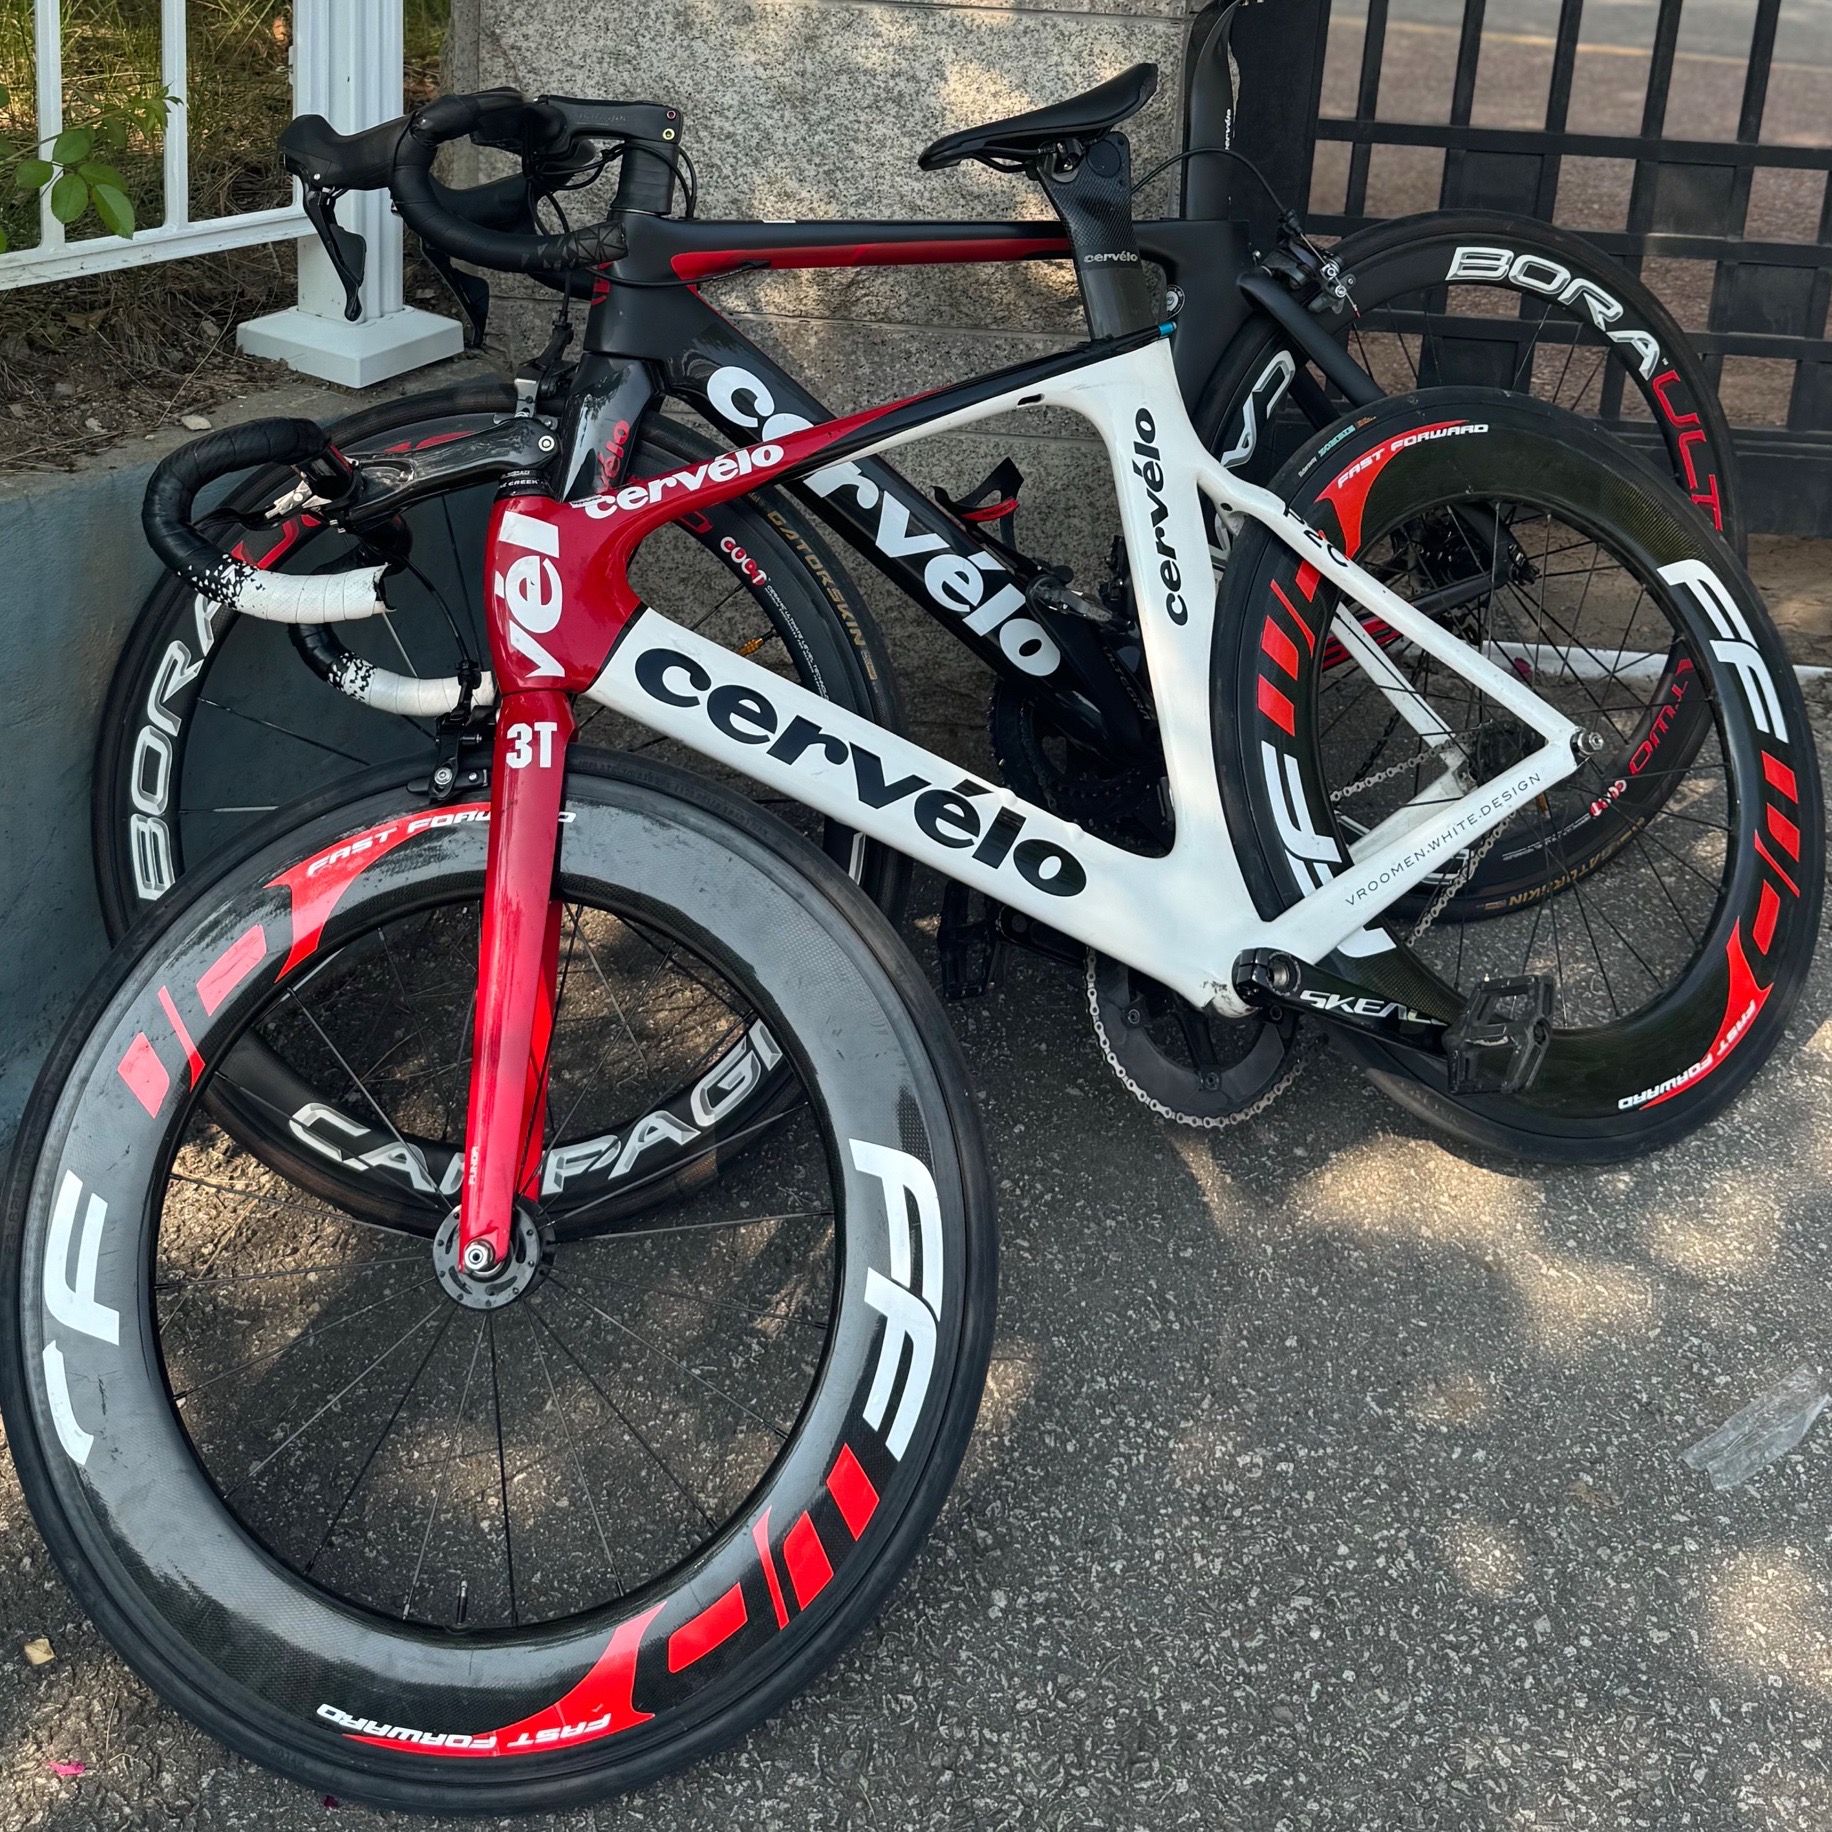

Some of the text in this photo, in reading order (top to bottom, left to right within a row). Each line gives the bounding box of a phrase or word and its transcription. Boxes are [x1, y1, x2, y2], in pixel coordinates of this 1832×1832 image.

[1084, 250, 1139, 263] cervélo
[1445, 246, 1661, 381] BORA
[584, 444, 784, 520] cervélo
[1337, 448, 1386, 489] FAST
[1390, 423, 1489, 452] FORWARD
[1134, 407, 1187, 626] cervélo
[766, 510, 866, 647] GATORSKIN
[505, 720, 559, 770] 3T
[635, 647, 1087, 898] cervélo
[306, 826, 398, 878] FAST
[1618, 999, 1757, 1110] FAST FORWARD
[316, 1703, 613, 1749] FAST FORWARD
